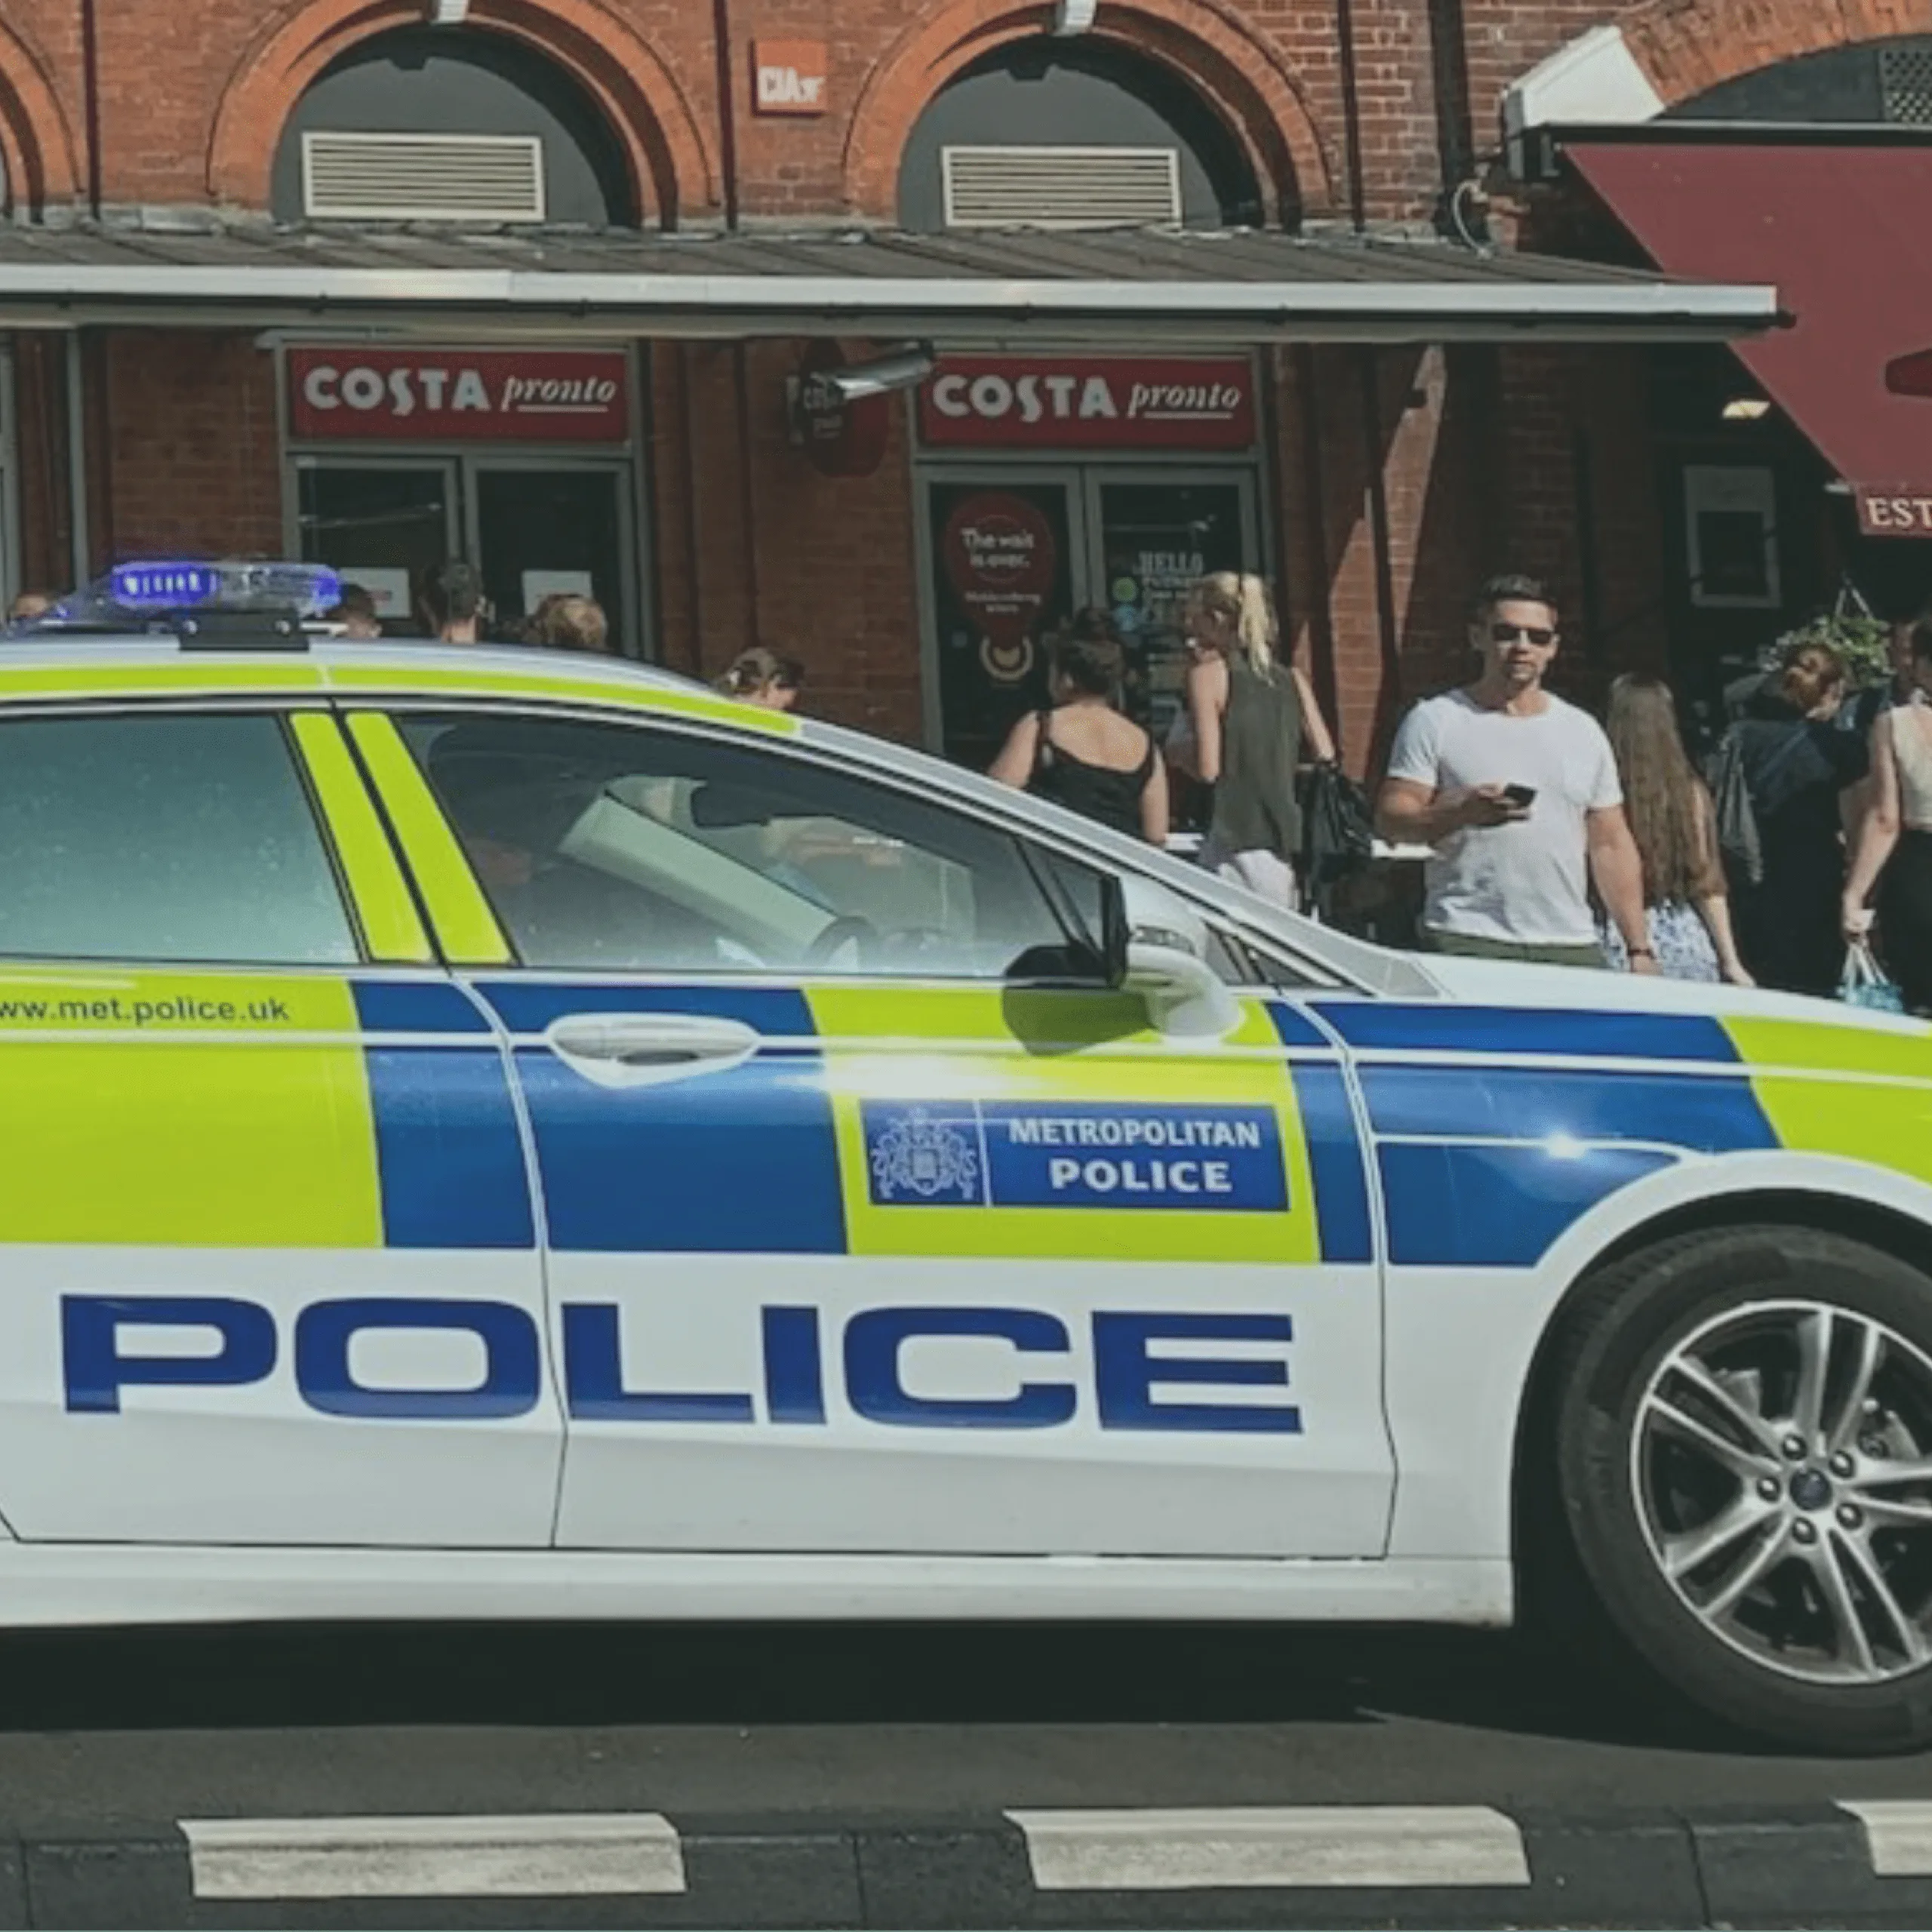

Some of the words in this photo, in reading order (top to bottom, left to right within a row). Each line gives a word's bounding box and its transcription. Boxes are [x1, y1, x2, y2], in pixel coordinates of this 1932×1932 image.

[303, 366, 491, 417] COSTA
[500, 375, 617, 412] pronto
[932, 374, 1118, 423] COSTA
[1127, 382, 1242, 419] pronto
[1008, 1118, 1261, 1149] METROPOLITAN
[1048, 1158, 1233, 1193] POLICE
[60, 1294, 1303, 1434] POLICE
